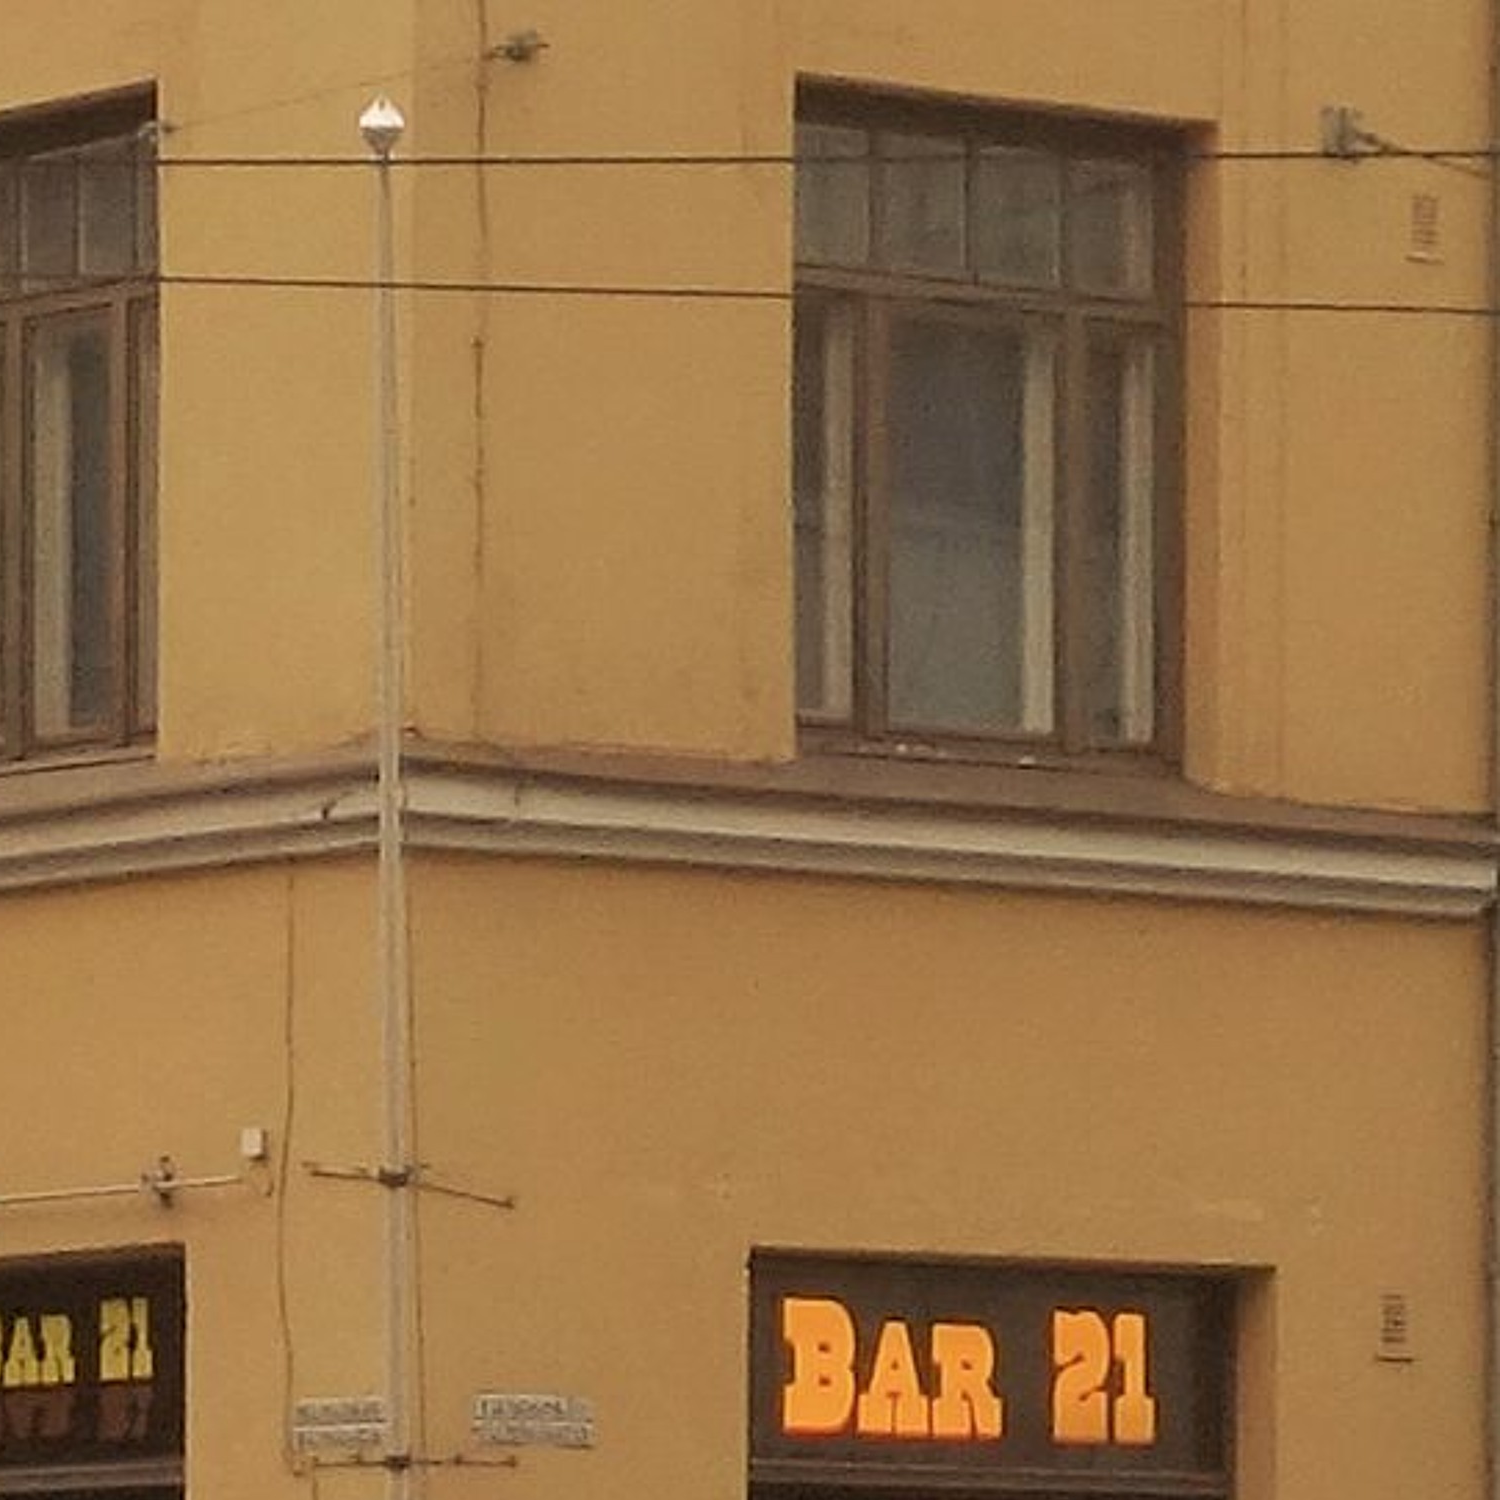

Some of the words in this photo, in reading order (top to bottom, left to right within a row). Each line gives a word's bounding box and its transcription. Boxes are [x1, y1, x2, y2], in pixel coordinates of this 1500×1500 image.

[99, 1296, 154, 1382] 21
[781, 1297, 1003, 1442] BAR
[1052, 1308, 1156, 1446] 21
